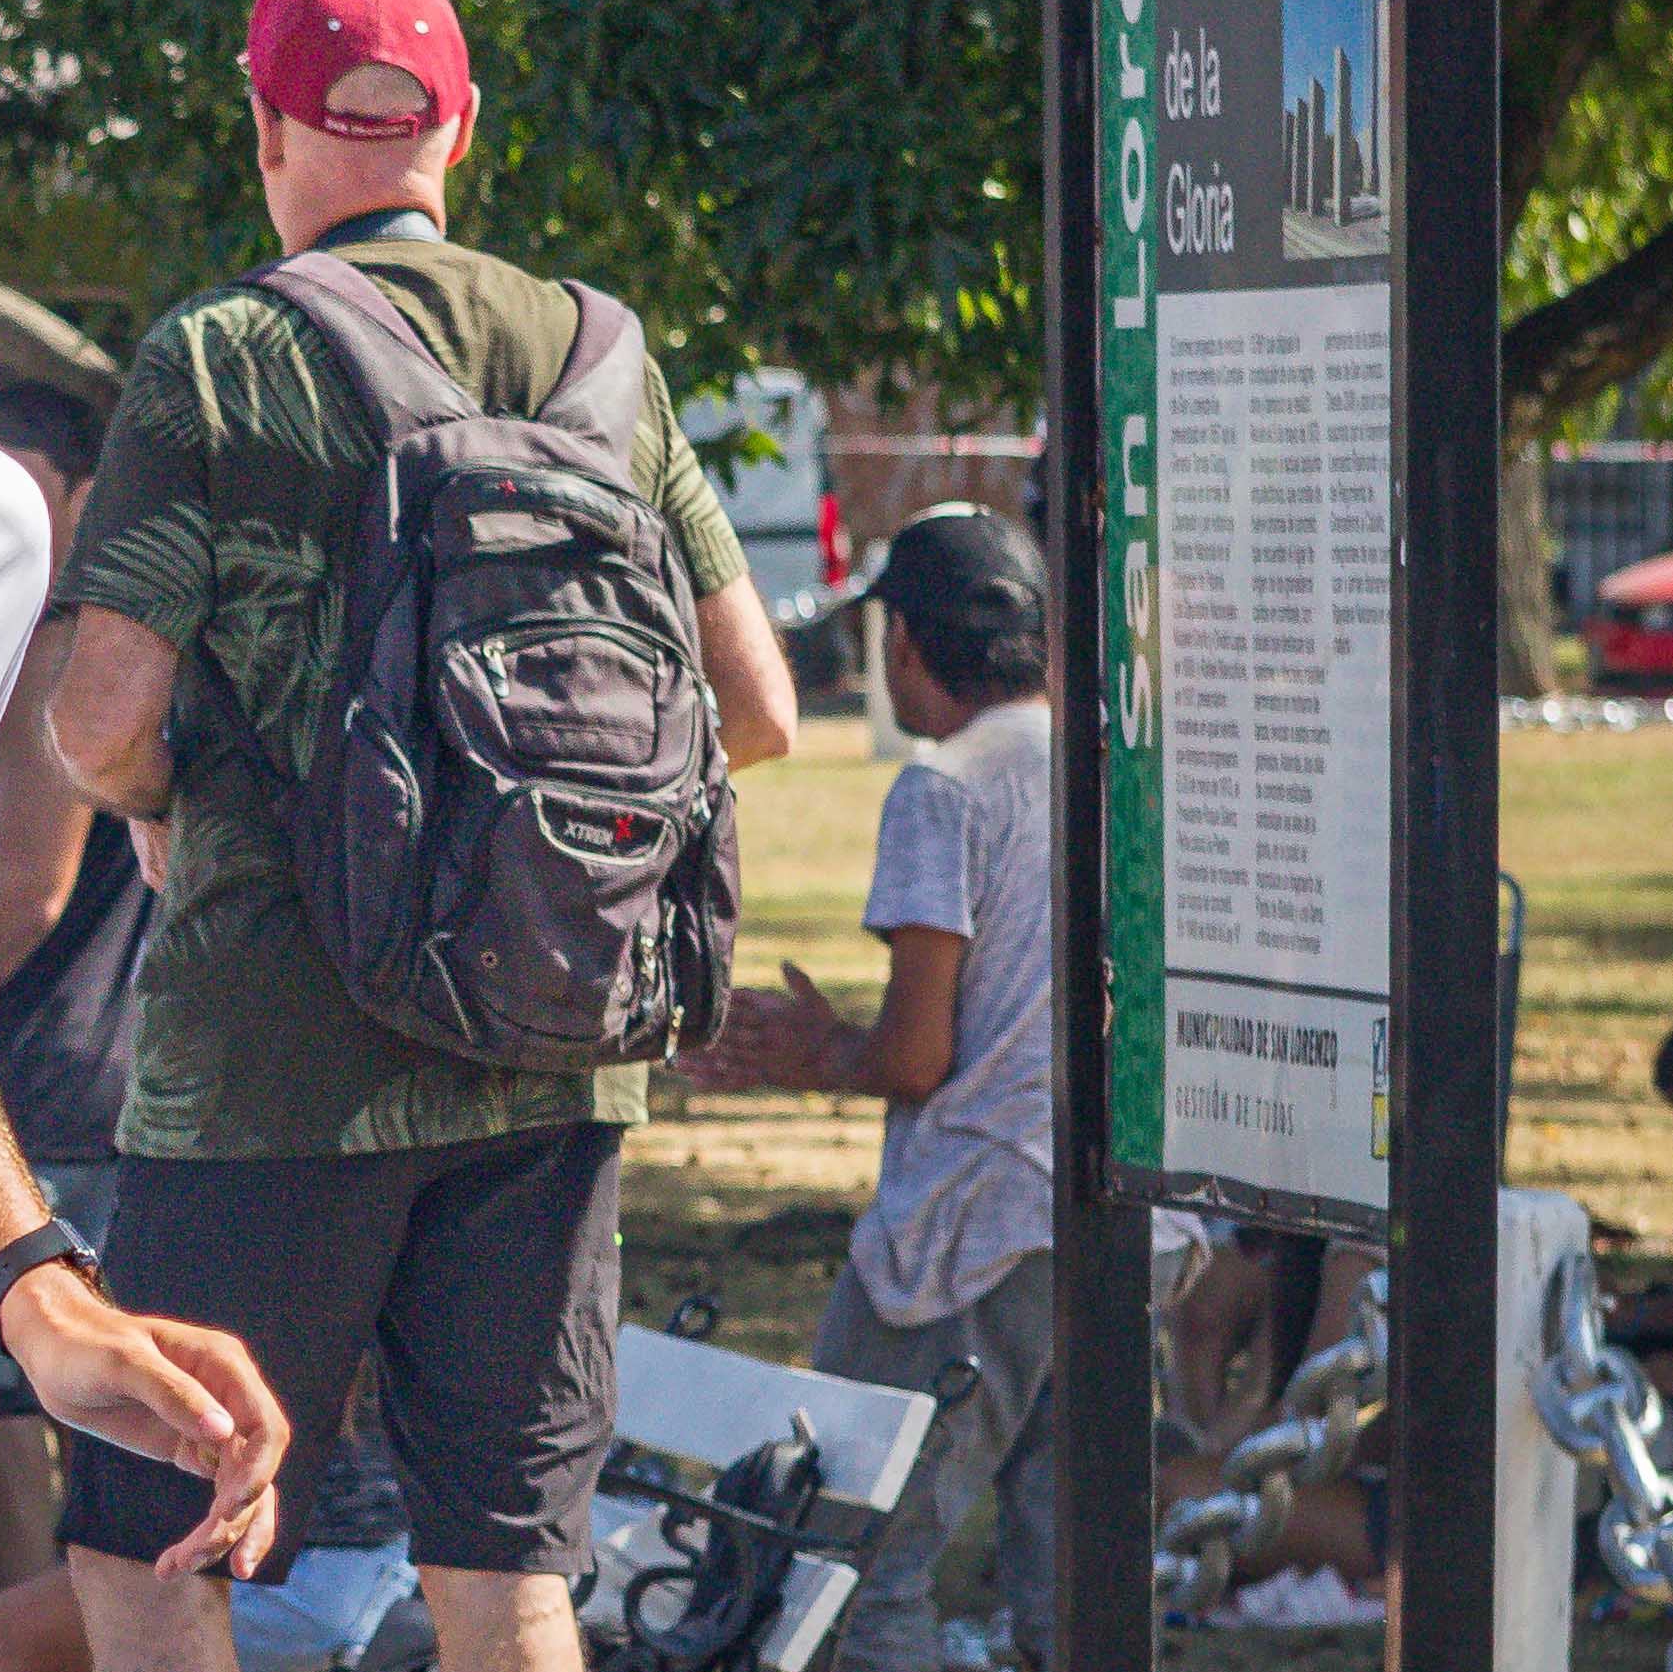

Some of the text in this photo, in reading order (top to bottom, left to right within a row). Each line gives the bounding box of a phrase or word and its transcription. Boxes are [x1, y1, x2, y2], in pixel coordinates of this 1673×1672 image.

[1164, 27, 1222, 121] de la
[1165, 160, 1235, 256] Gloria
[1120, 413, 1153, 749] San
[1176, 1009, 1338, 1070] MUNICIPALIDAD DE SAN LORENZO
